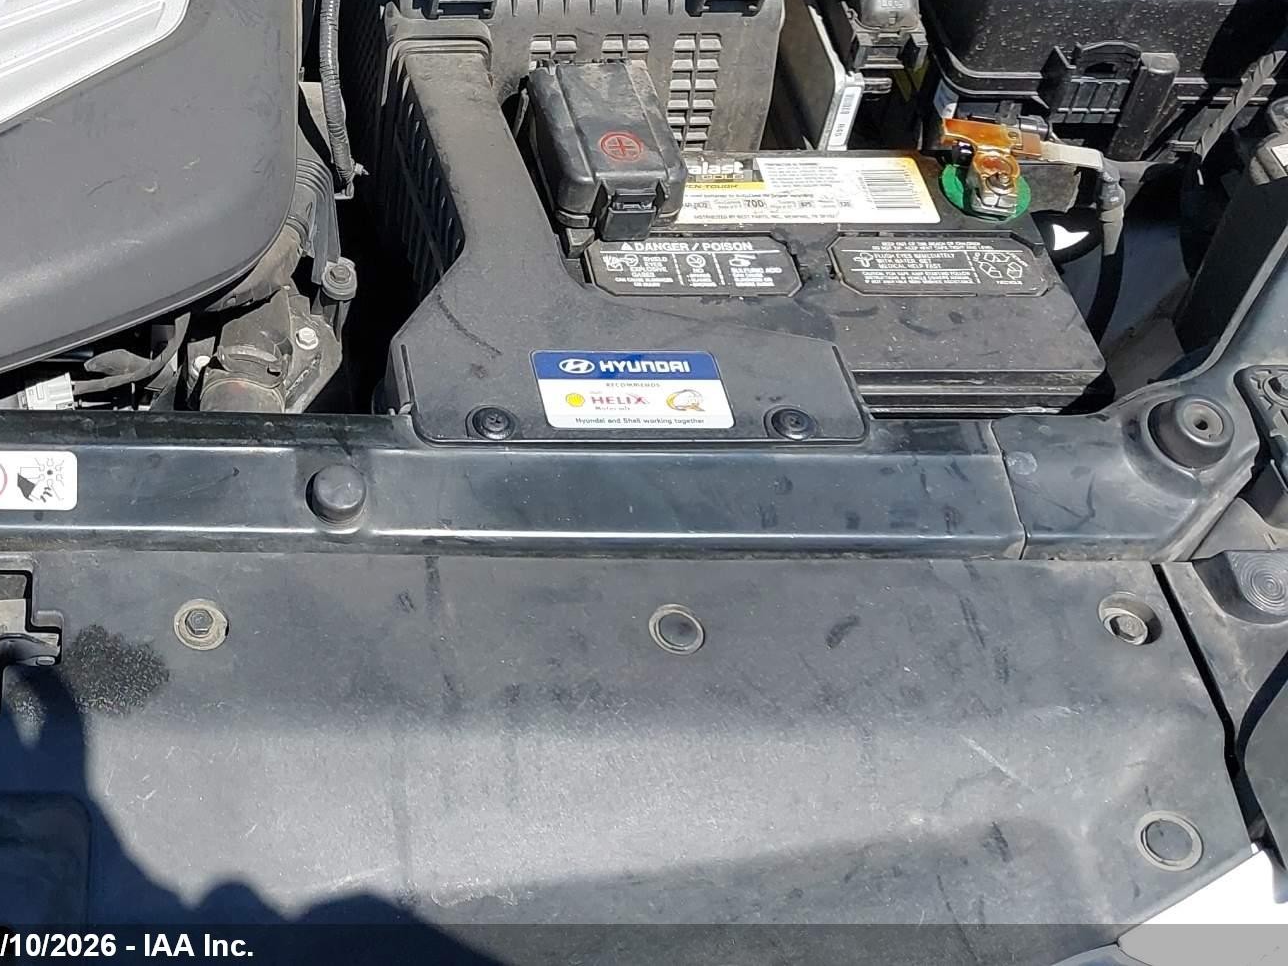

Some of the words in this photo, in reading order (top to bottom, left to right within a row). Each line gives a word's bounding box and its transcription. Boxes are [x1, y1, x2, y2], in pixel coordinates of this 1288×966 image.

[687, 161, 744, 174] alast
[744, 200, 764, 208] 700
[634, 242, 690, 251] DANGER
[691, 242, 699, 251] /
[702, 242, 753, 251] POISON
[599, 360, 691, 373] HYUNDAI
[591, 395, 650, 405] HELIX
[575, 417, 606, 425] Hyundai
[643, 417, 673, 426] working
[674, 417, 705, 426] together
